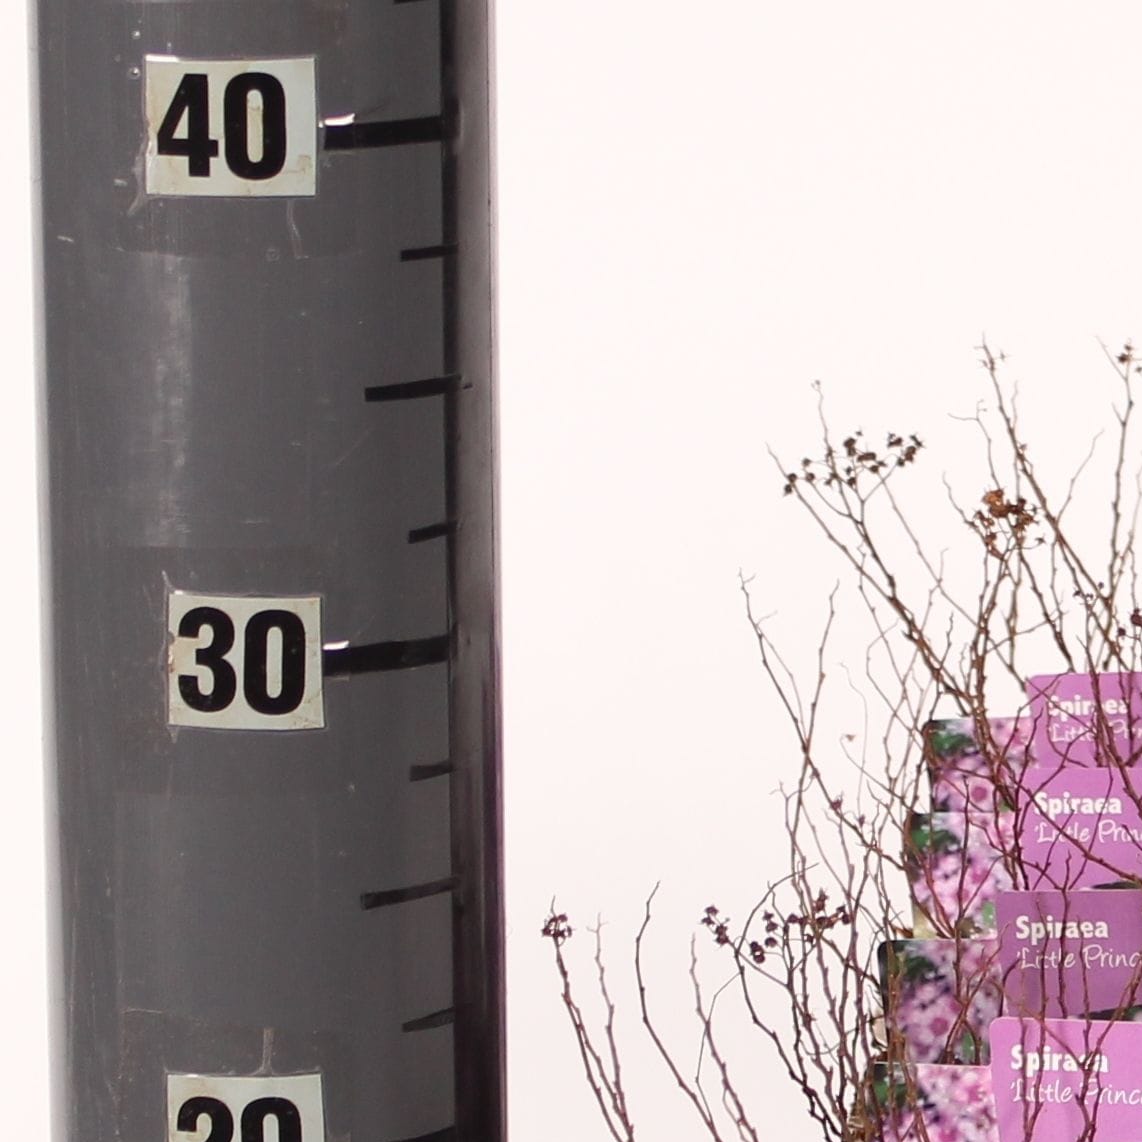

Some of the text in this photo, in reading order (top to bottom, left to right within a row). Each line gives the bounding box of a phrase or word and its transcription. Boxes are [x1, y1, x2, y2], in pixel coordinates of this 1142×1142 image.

[157, 72, 286, 180] 40
[177, 607, 306, 715] 30
[1048, 695, 1129, 722] Spirea
[1034, 791, 1122, 819] Spiraea
[1015, 915, 1109, 946] Spiraea
